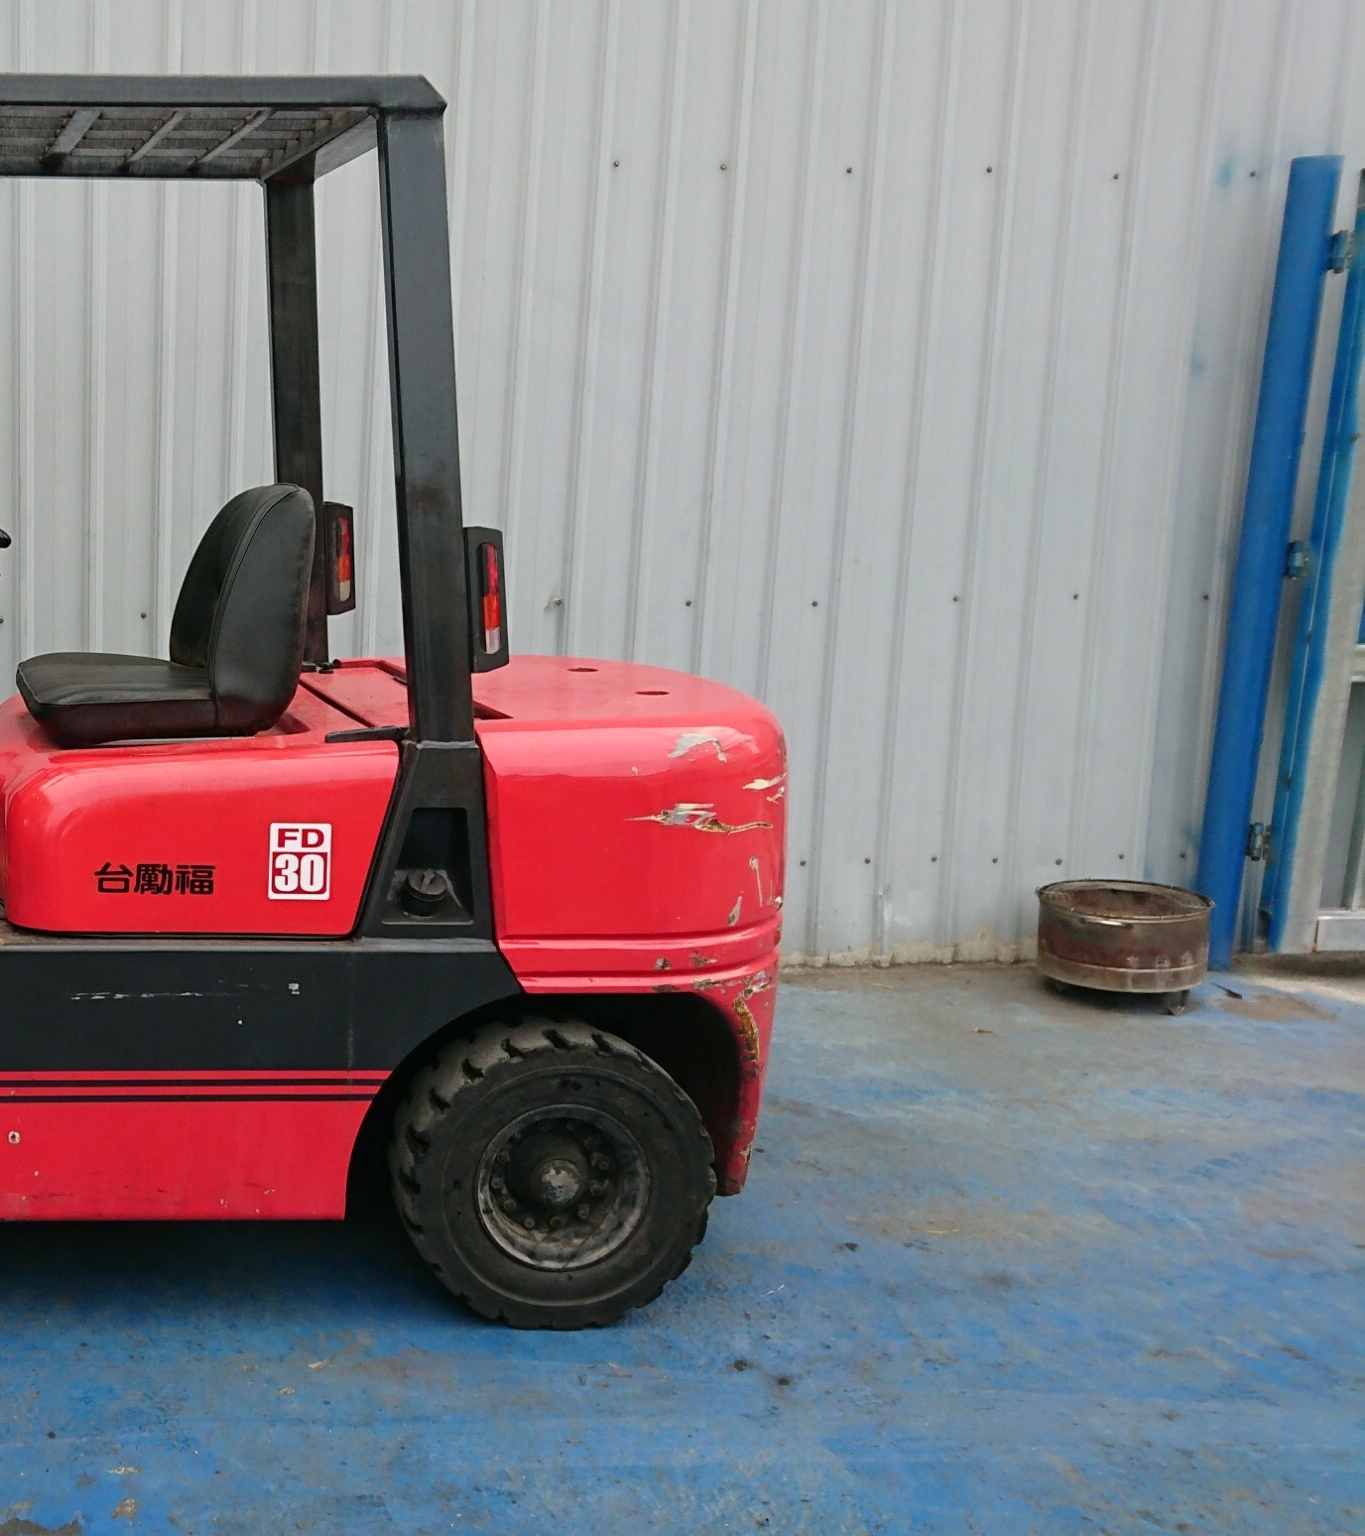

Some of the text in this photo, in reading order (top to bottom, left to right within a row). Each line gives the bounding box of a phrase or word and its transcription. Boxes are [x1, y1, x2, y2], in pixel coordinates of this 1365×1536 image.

[277, 828, 325, 848] FD
[94, 862, 216, 895] 台勵福
[274, 853, 325, 892] 30
